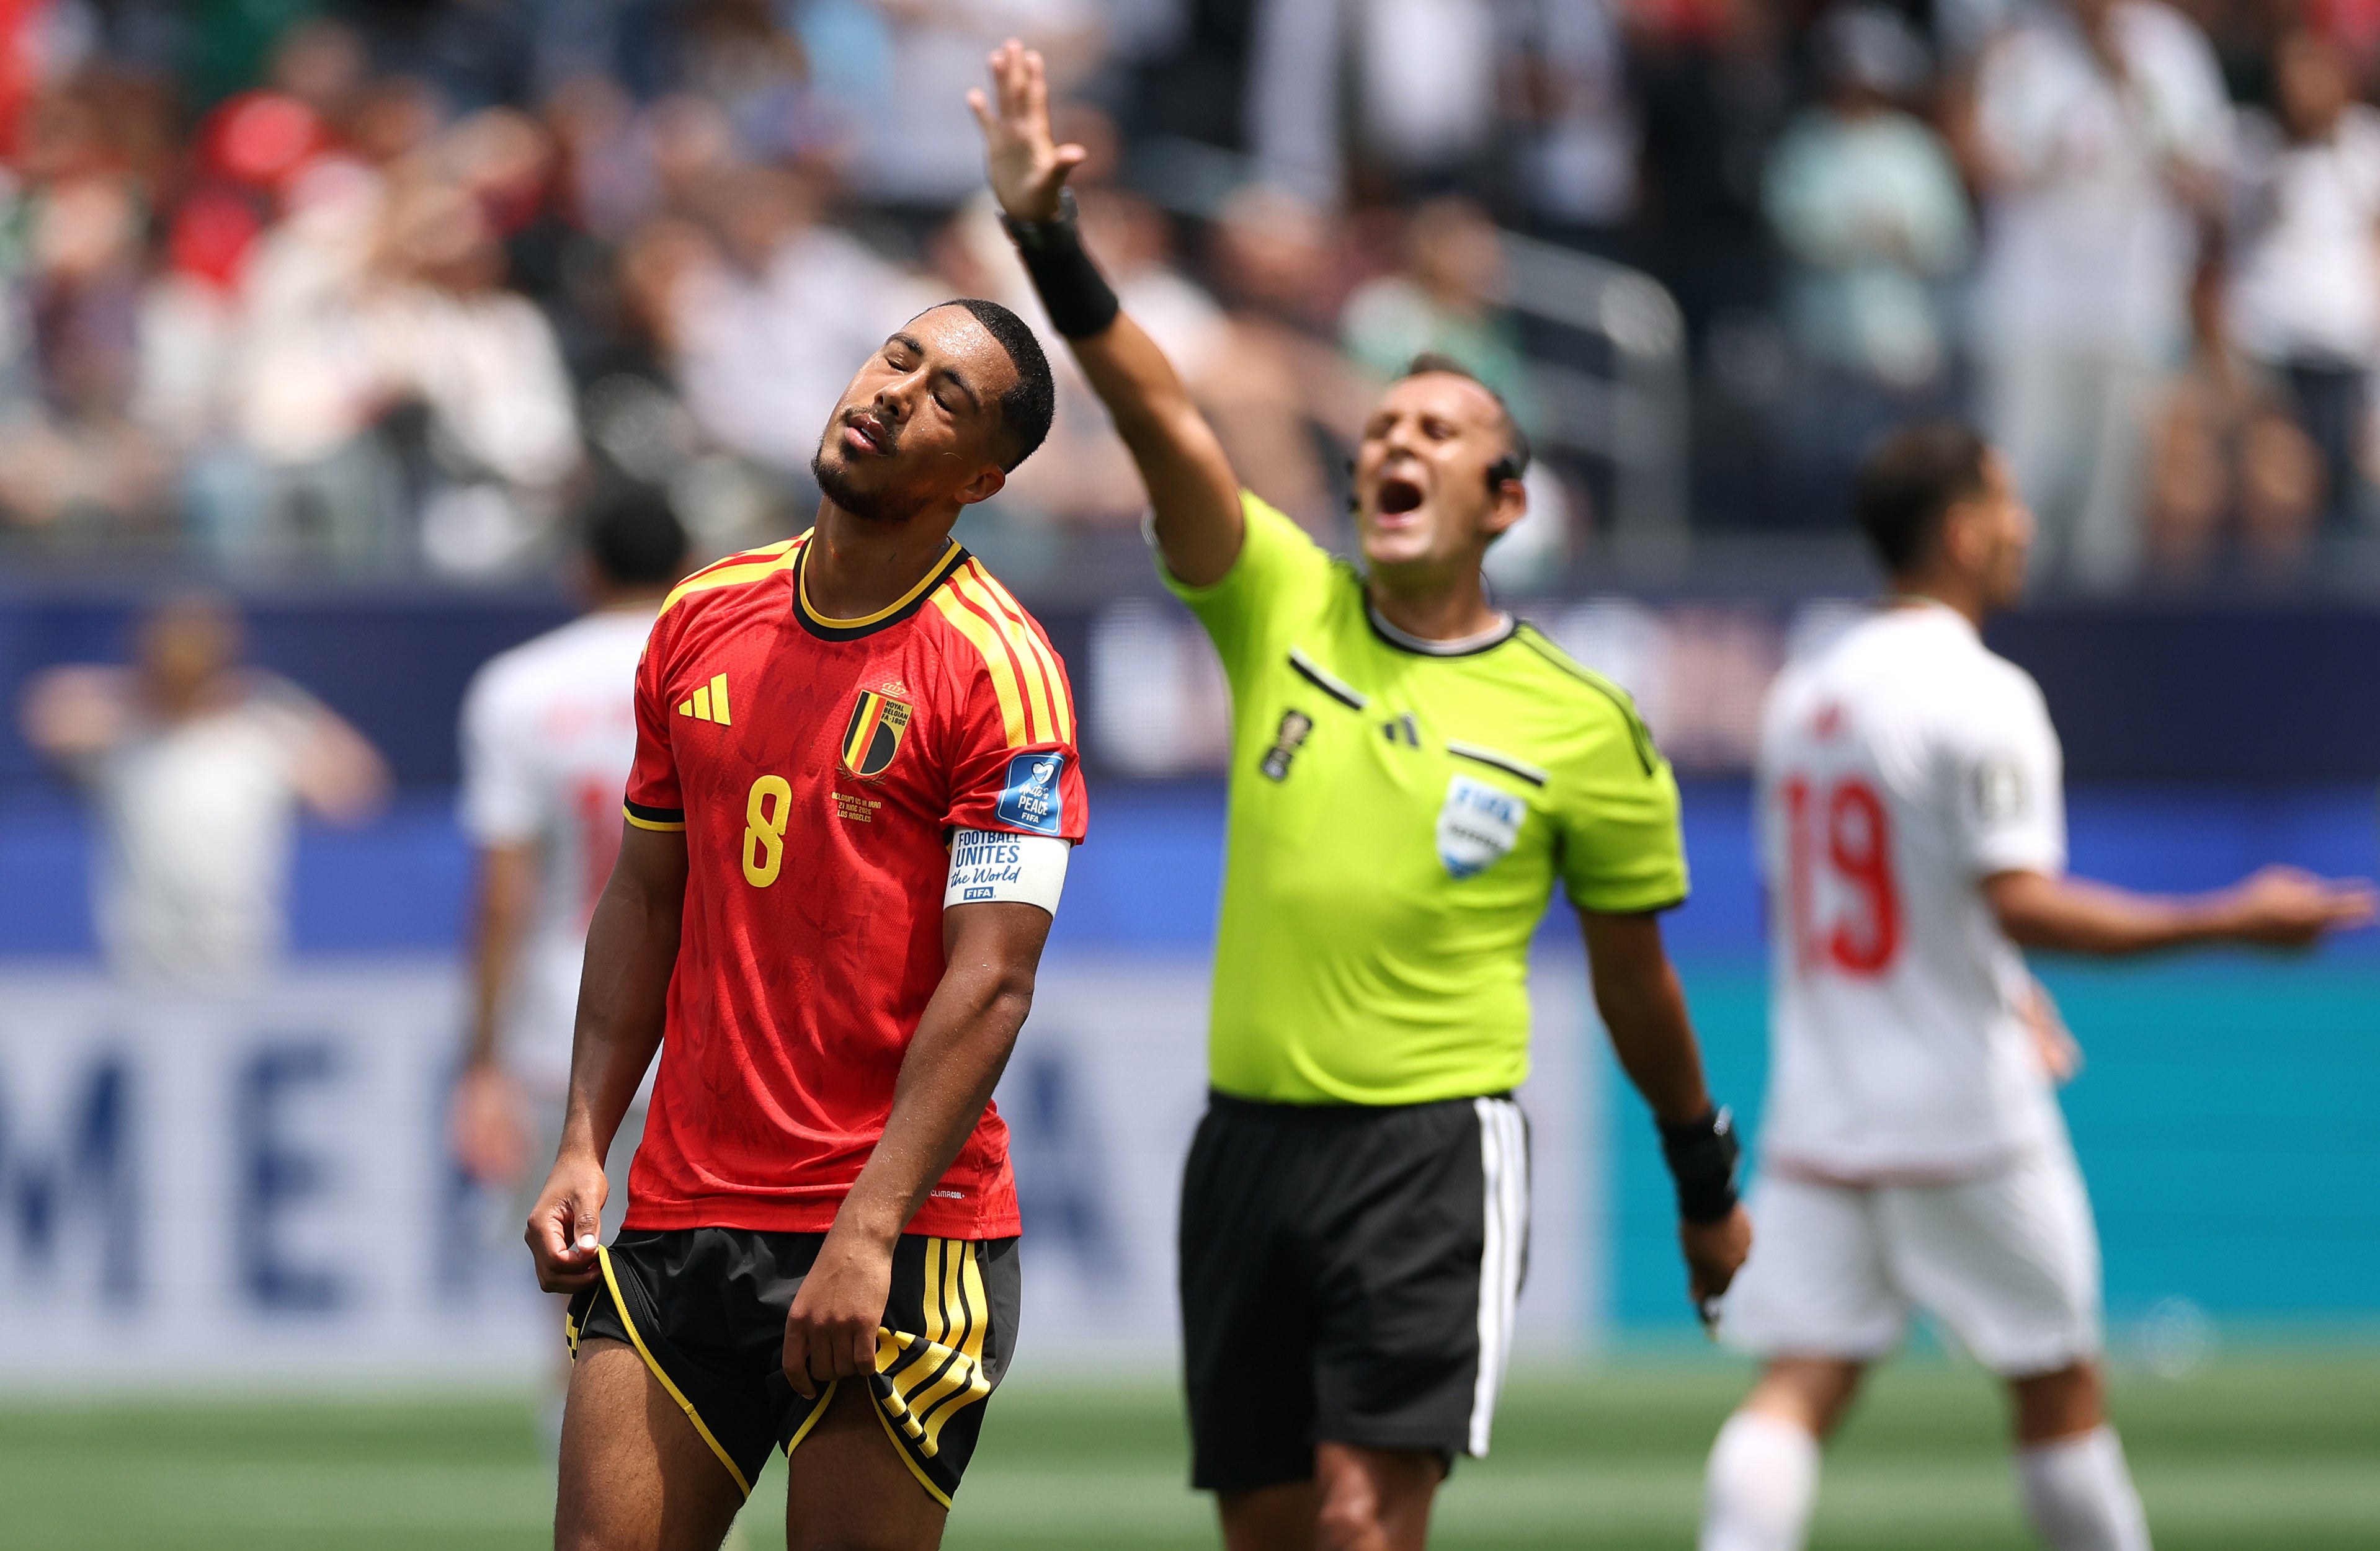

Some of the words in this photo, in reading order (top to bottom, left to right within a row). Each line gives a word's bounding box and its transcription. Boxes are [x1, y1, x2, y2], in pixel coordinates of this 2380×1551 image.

[883, 707, 909, 719] BELGIAN
[886, 701, 904, 711] ROYAL
[832, 792, 854, 803] BELGIUM
[868, 801, 881, 809] IRAN
[1018, 795, 1048, 815] PEACE
[837, 809, 848, 818] LOS
[849, 812, 871, 823] ANGELES
[1022, 812, 1039, 824] FIFA
[742, 775, 791, 887] 8
[958, 830, 1021, 847] FOOTBALL
[956, 845, 1020, 868] UNITES
[951, 869, 970, 888] the
[973, 865, 1022, 884] World
[1774, 769, 1907, 980] 19
[966, 889, 992, 899] FIFA
